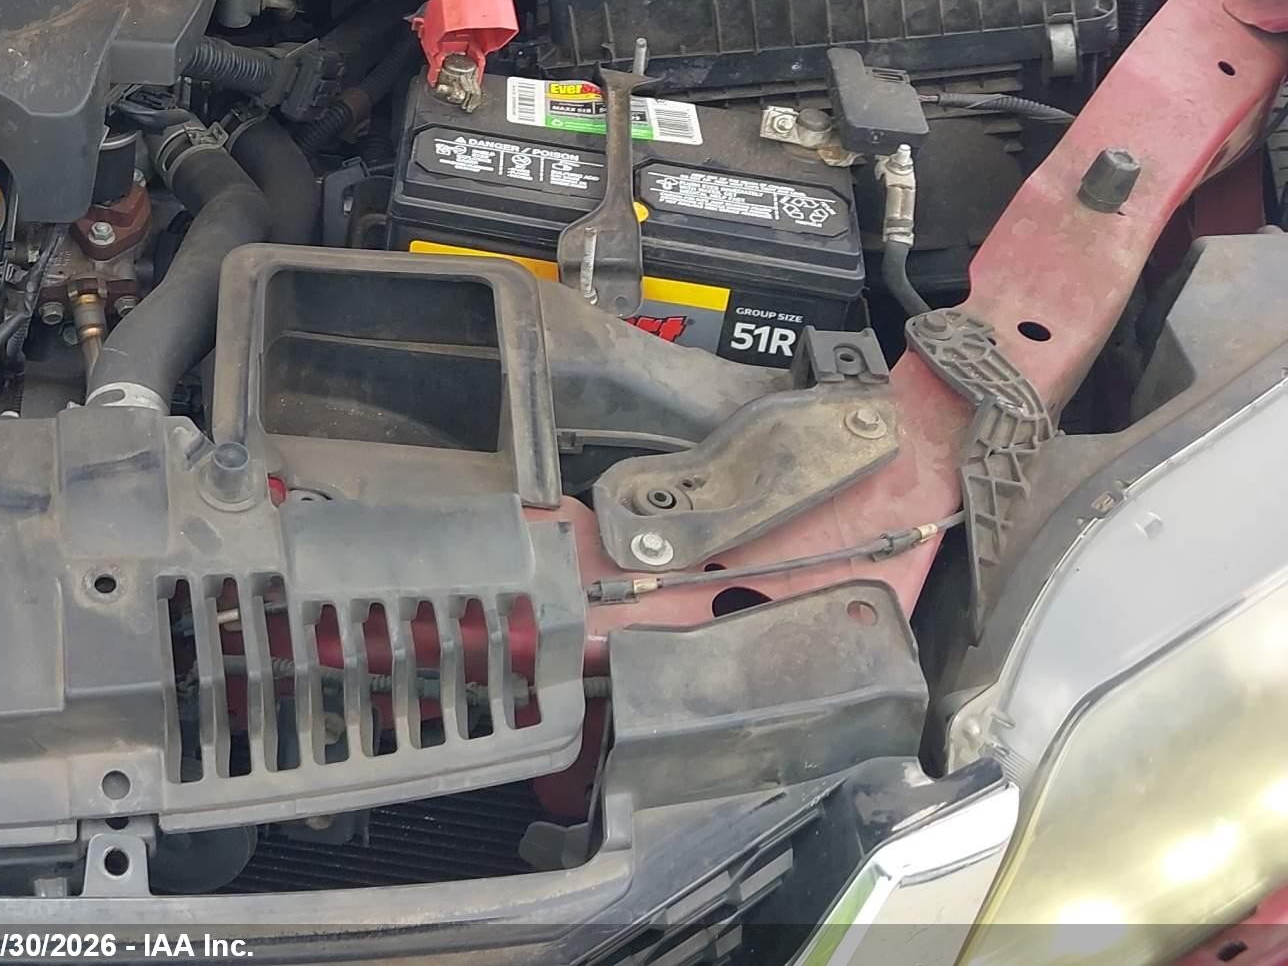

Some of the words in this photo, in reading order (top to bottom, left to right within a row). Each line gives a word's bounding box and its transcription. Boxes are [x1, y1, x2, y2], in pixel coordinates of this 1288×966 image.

[468, 138, 521, 153] DANGER
[532, 147, 580, 162] POISON
[735, 306, 777, 320] GROUP
[777, 313, 805, 324] SIZE
[730, 322, 797, 357] 51R
